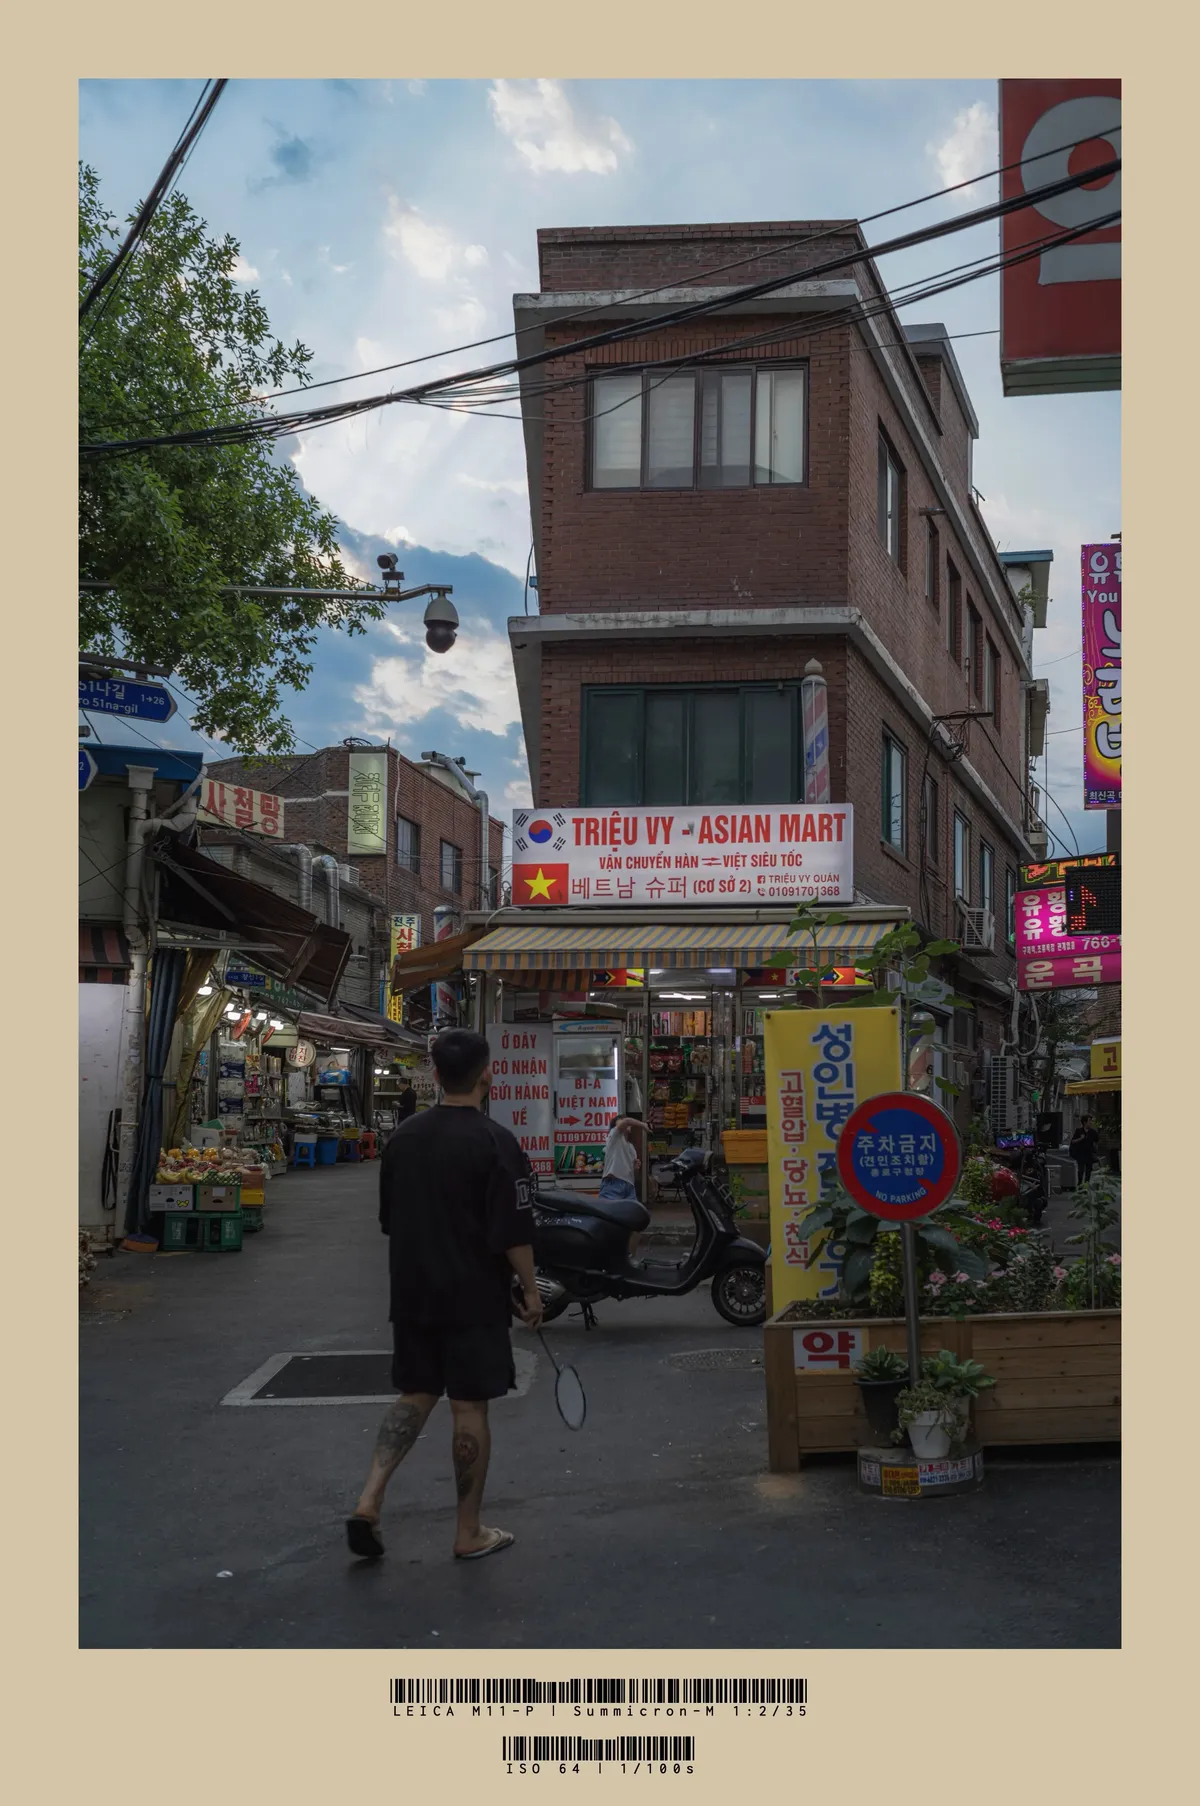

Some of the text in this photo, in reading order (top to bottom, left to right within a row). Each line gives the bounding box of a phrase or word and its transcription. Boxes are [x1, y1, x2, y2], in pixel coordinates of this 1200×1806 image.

[1087, 590, 1118, 604] You
[92, 697, 138, 714] 51na-gil
[1089, 790, 1116, 801] 최신곡
[204, 781, 280, 835] 사철탕
[572, 810, 637, 852] TRIỆU
[646, 816, 674, 845] VY
[698, 814, 771, 844] ASIAN
[779, 813, 846, 843] MART
[599, 849, 803, 872] VẬN CHUYỂN HÀN VIỆT SIÊU TỐC
[572, 876, 636, 899] 베트남
[645, 876, 687, 898] 슈퍼
[719, 875, 736, 892] SỞ
[739, 879, 752, 894] 2)
[768, 872, 796, 885] TRIỆU
[798, 875, 811, 883] VY
[768, 886, 840, 897] 01091701368
[502, 1030, 537, 1049] Ở ĐÂY
[492, 1055, 547, 1078] CÓ NHẬN
[515, 1081, 549, 1100] HÀNG
[575, 1078, 601, 1090] BI-A
[559, 1096, 617, 1110] VIỆT NAM
[520, 1136, 549, 1151] NAM
[857, 1132, 936, 1155] 주차금지
[875, 1187, 927, 1204] NO PARKING
[802, 1331, 856, 1369] 약
